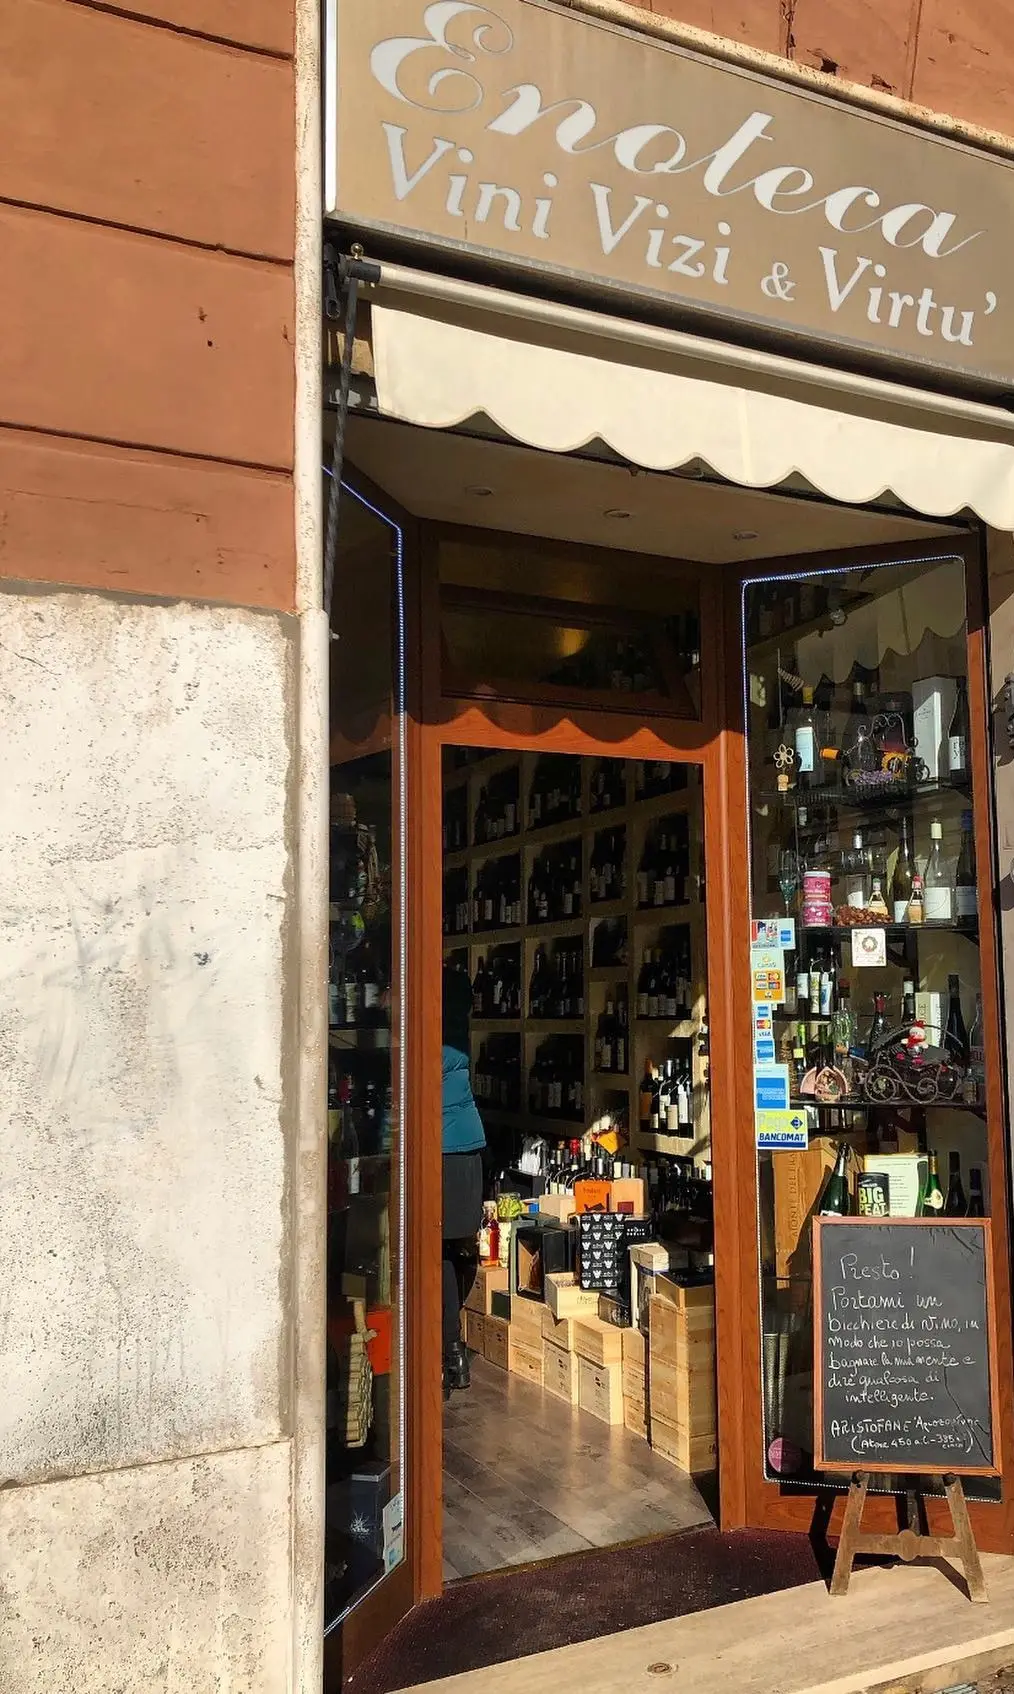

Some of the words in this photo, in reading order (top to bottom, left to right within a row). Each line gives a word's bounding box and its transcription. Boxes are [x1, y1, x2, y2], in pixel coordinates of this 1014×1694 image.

[370, 0, 985, 257] Enoteca
[381, 121, 557, 239] Vini
[589, 182, 732, 285] Vizi
[760, 261, 796, 301] &
[760, 1133, 805, 1141] BANCOMAT
[858, 1186, 885, 1204] BIG
[859, 1203, 886, 1216] PEAT
[831, 1286, 905, 1310] Portami
[828, 1312, 898, 1332] bicchiere
[867, 1335, 888, 1349] che
[906, 1337, 951, 1355] possa
[828, 1351, 879, 1376] bagnare
[881, 1352, 893, 1366] la
[916, 1351, 960, 1367] mente
[859, 1371, 919, 1391] qualcosa
[925, 1371, 940, 1382] di
[891, 1438, 912, 1447] 450
